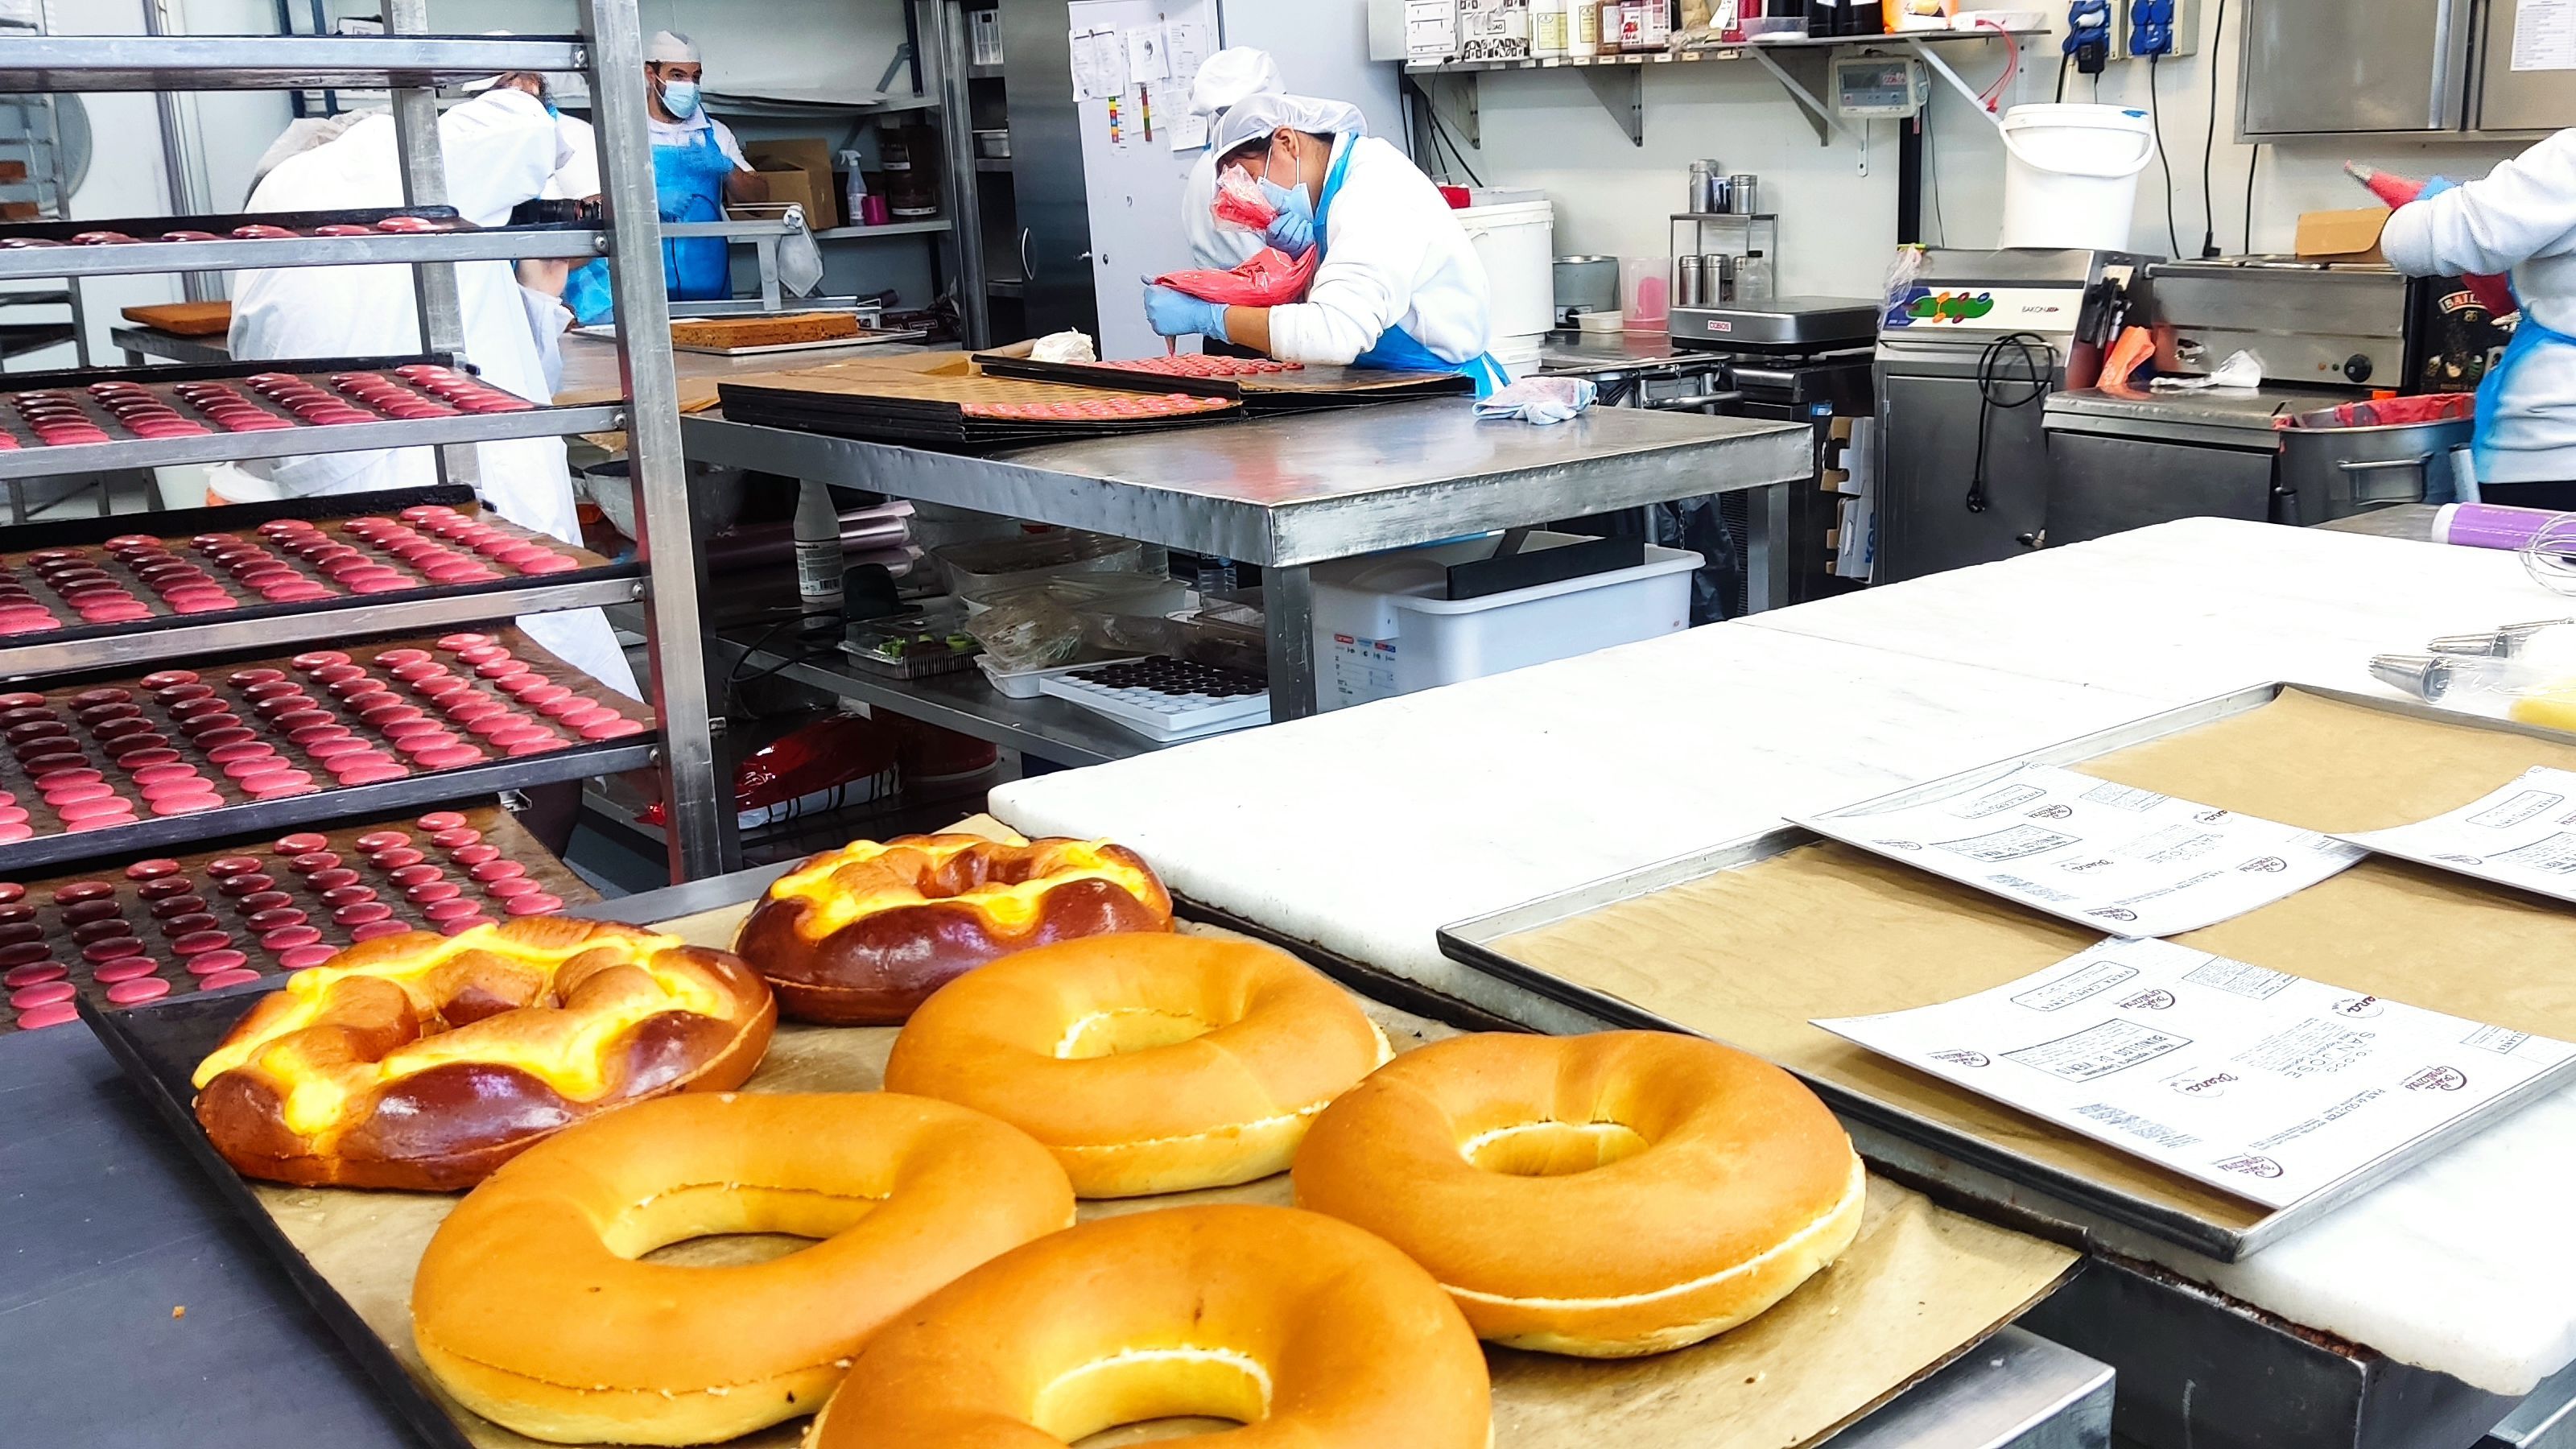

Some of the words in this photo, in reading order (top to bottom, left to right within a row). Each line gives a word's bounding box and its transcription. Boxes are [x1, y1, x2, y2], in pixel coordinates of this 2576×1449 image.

[2444, 293, 2481, 308] BAIL
[1709, 321, 1730, 330] COBOS
[2336, 1030, 2376, 1054] SAN
